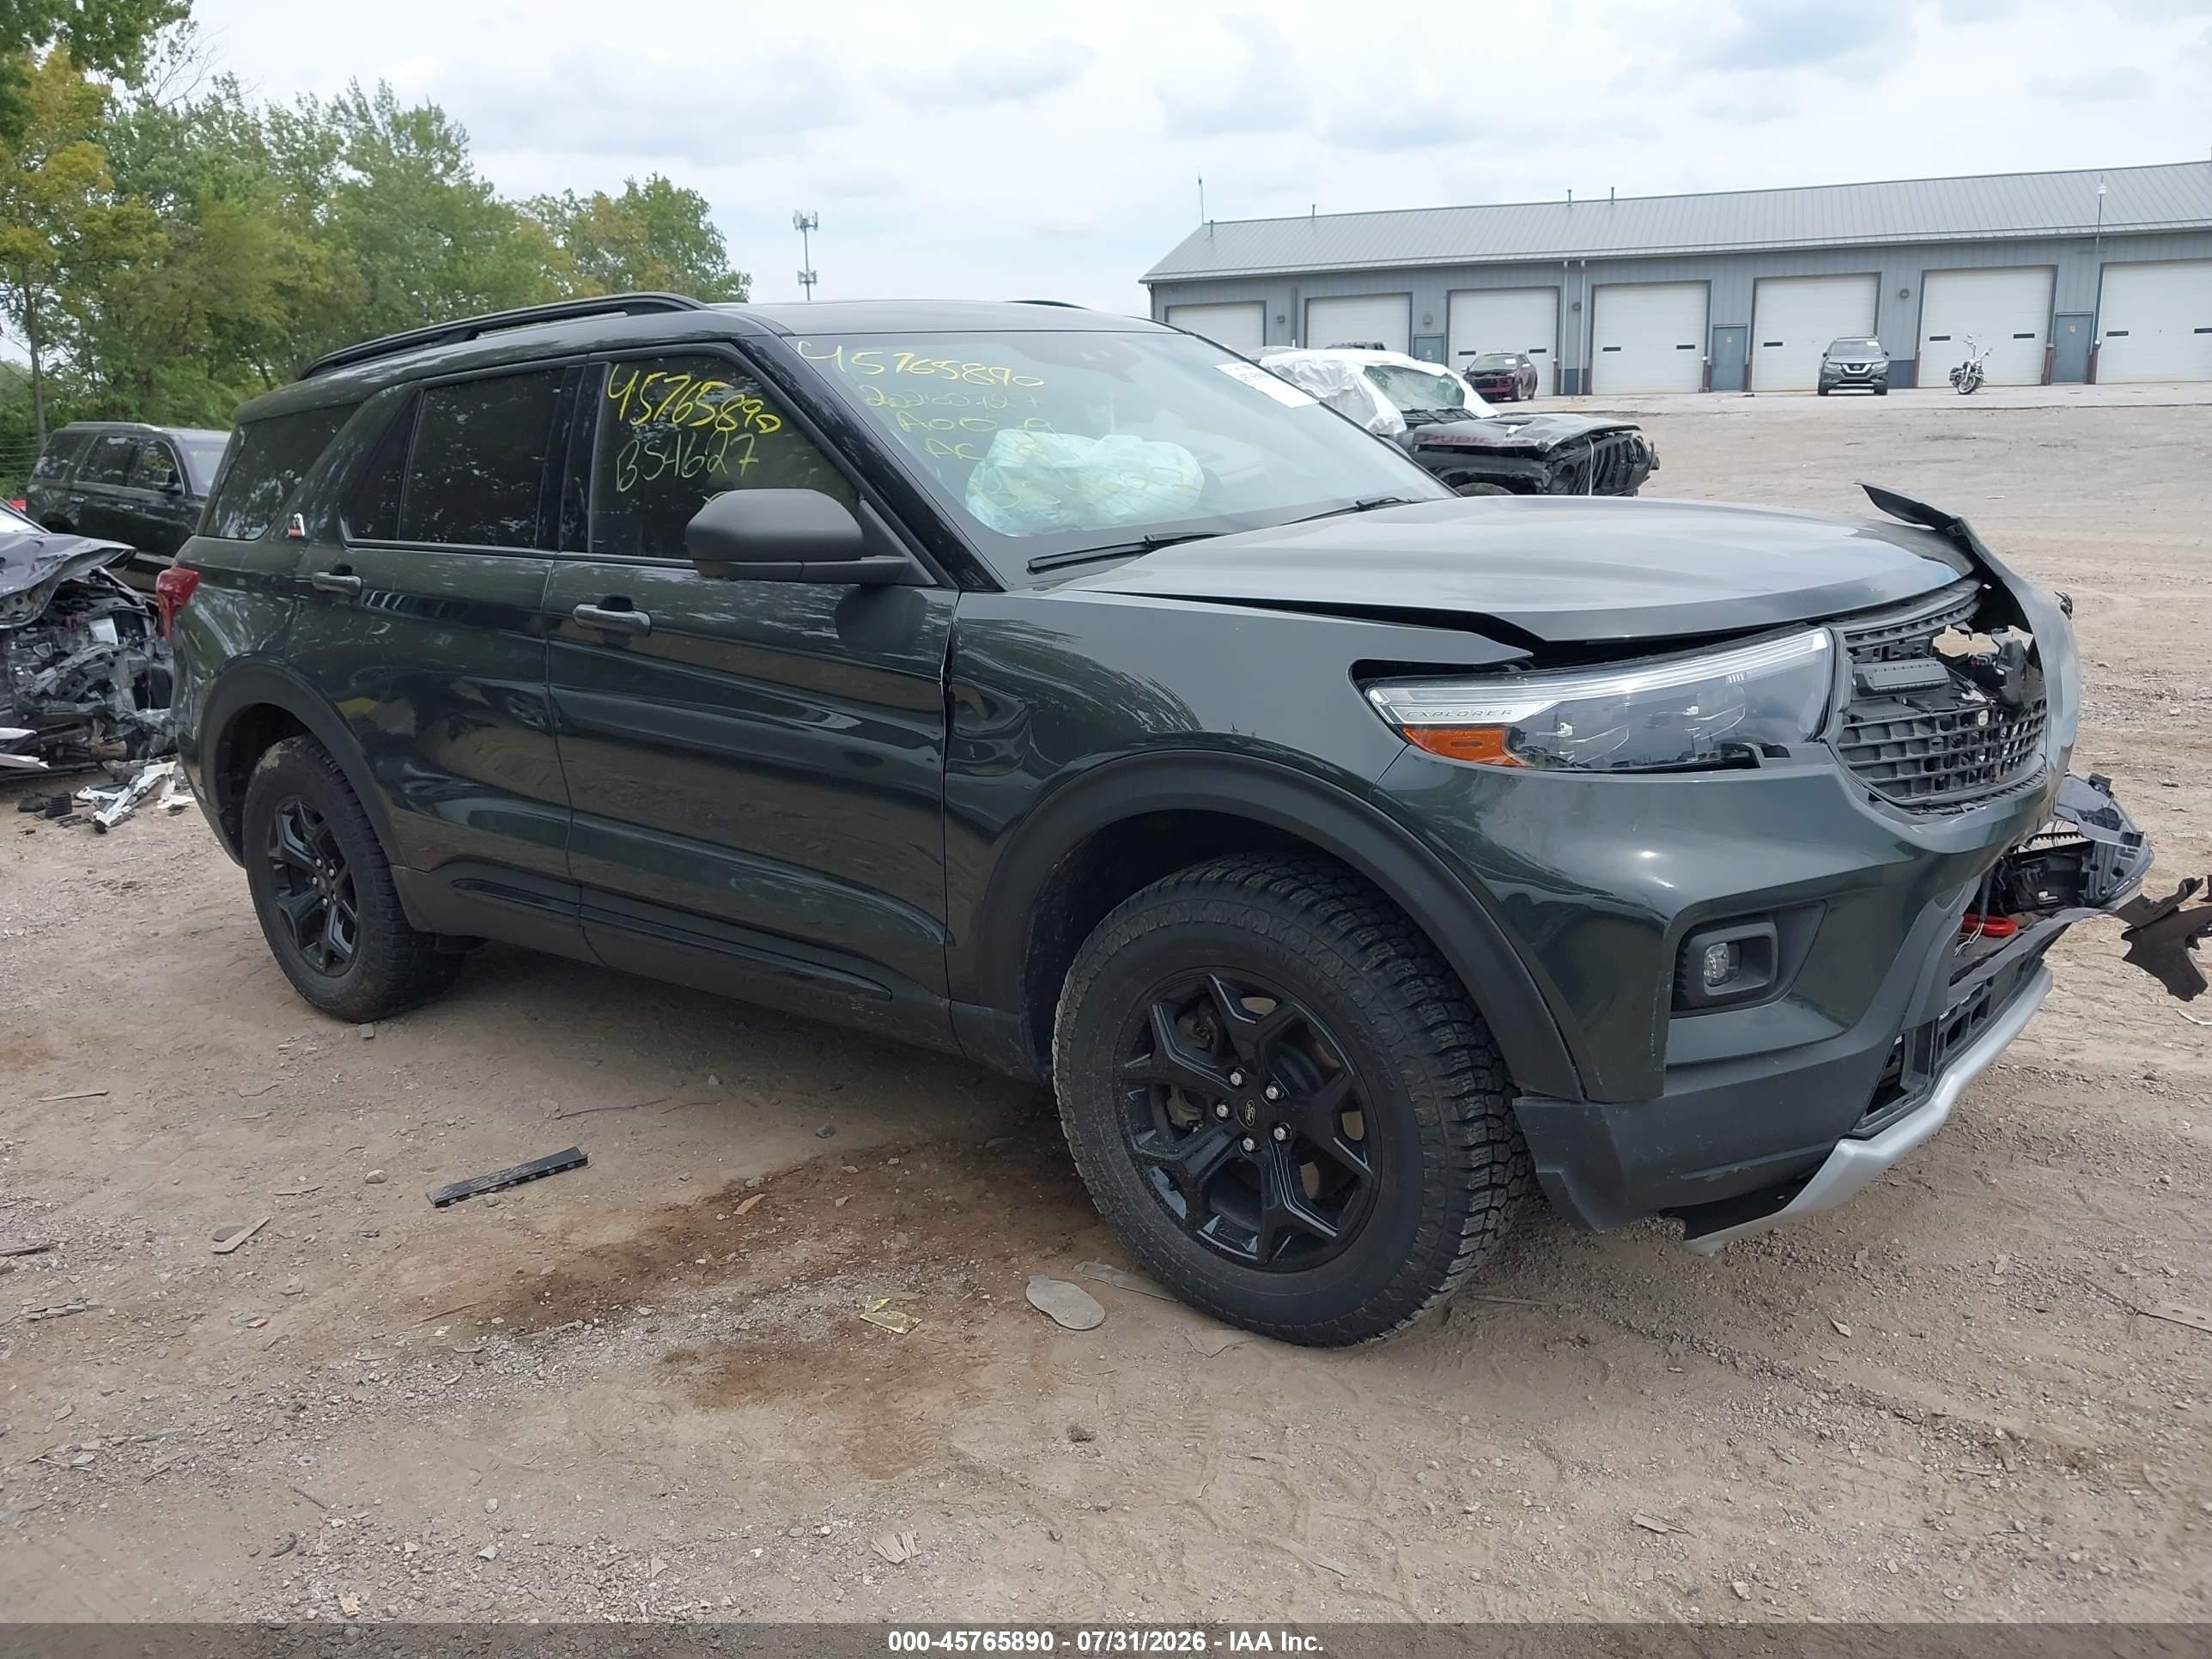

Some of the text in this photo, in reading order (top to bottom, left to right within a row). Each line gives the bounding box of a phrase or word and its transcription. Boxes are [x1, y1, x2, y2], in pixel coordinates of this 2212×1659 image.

[797, 341, 1045, 386] 45765890
[607, 363, 782, 434] 45765890
[1423, 434, 1530, 445] RUBIC
[1406, 708, 1514, 719] EXPLORER
